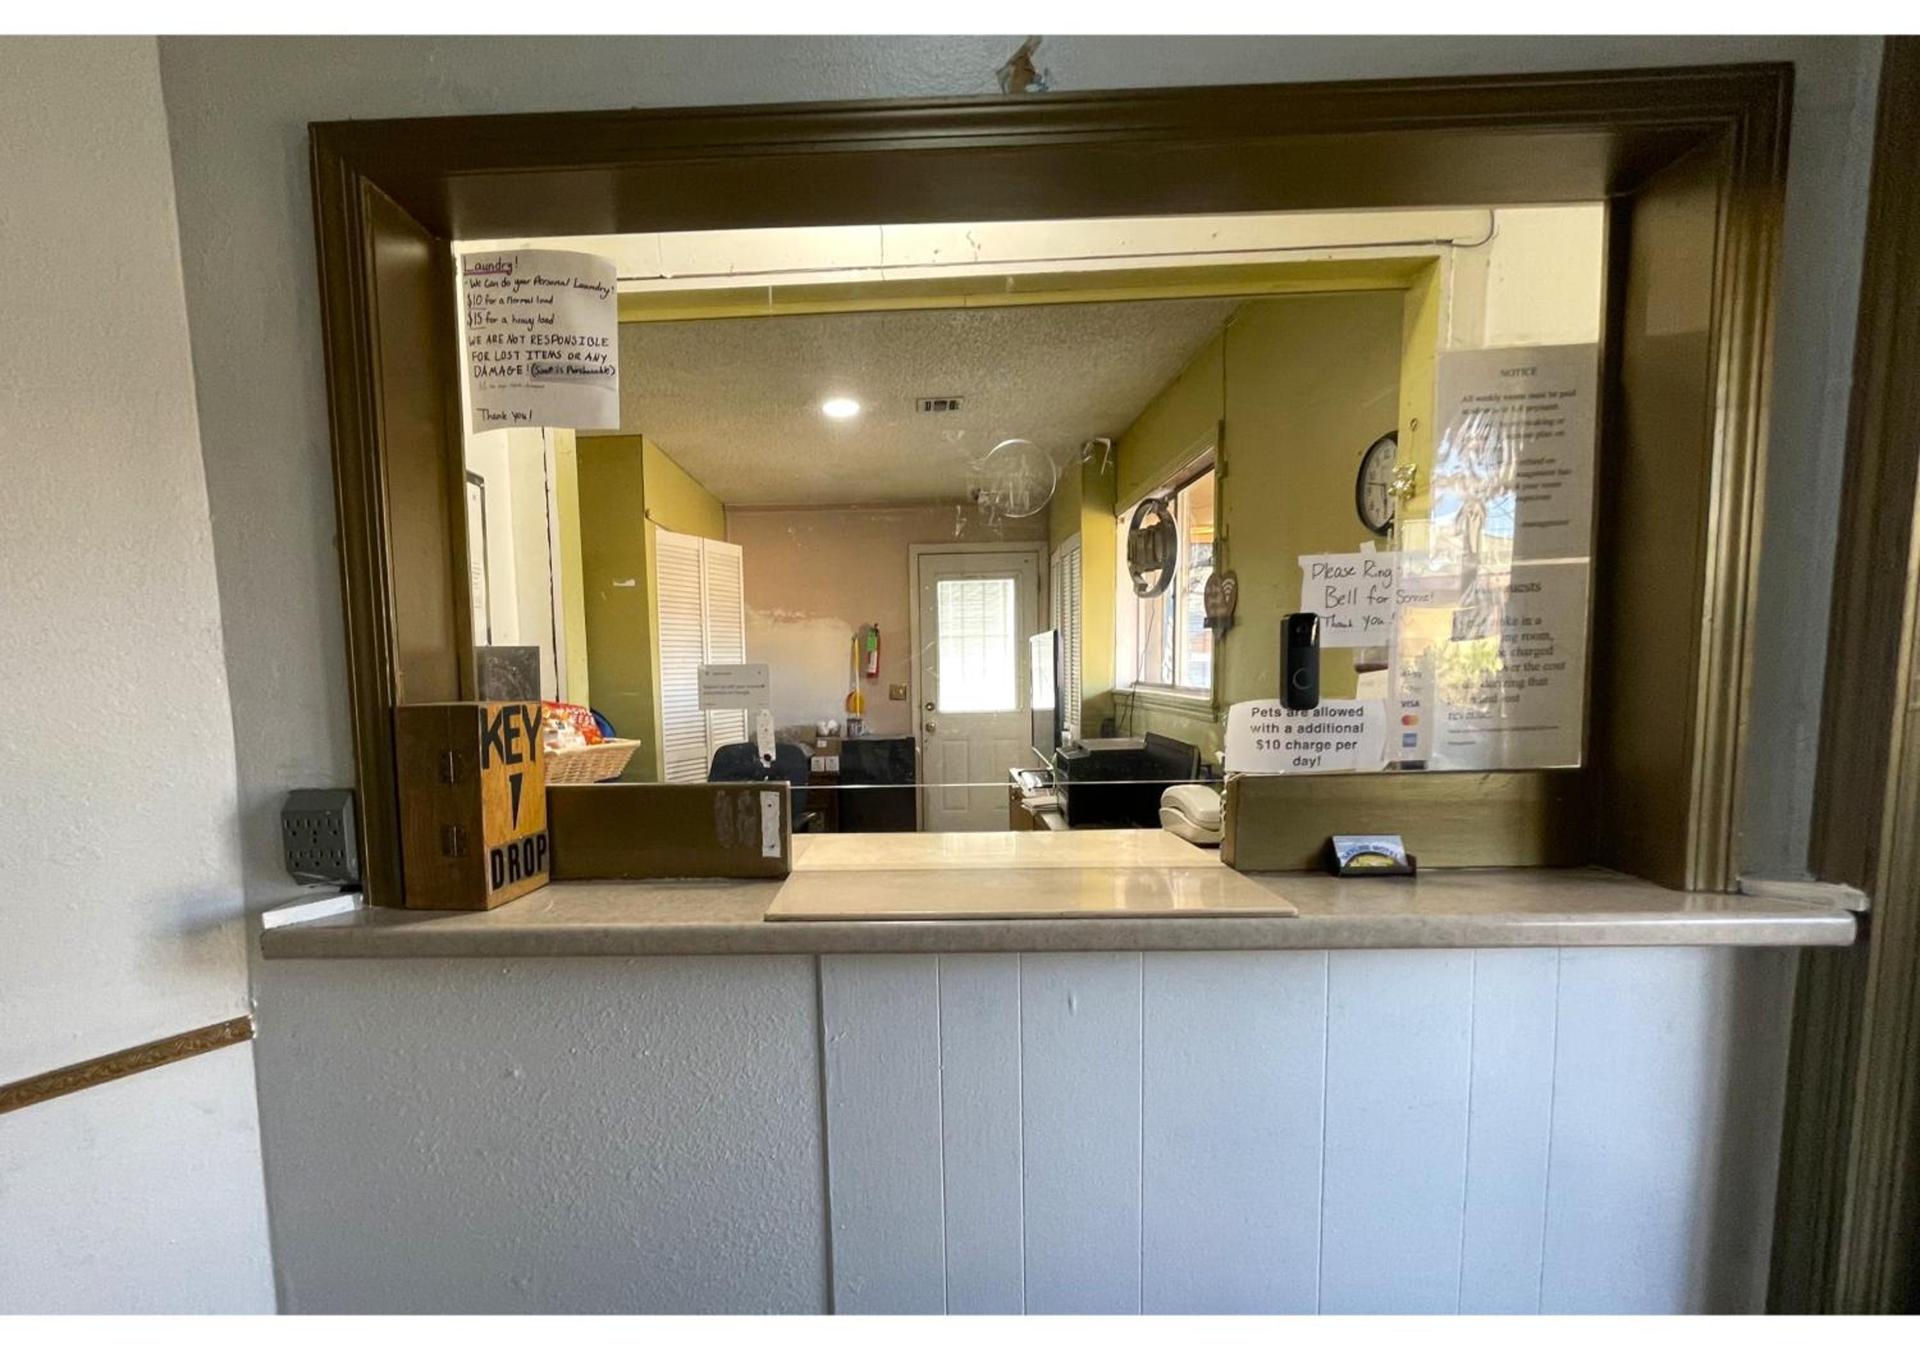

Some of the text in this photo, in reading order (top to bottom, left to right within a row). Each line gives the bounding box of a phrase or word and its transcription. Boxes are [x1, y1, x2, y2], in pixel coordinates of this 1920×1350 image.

[463, 255, 518, 275] Laundry!
[501, 276, 511, 288] do
[512, 279, 531, 293] your
[467, 293, 482, 308] $10
[485, 294, 497, 305] for
[498, 297, 505, 305] a
[467, 311, 482, 327] $15
[486, 311, 498, 323] for
[501, 316, 508, 324] a
[538, 313, 555, 324] load
[469, 334, 609, 347] WE ARE NOT RESPONSIBLE
[472, 350, 608, 364] FOR LOST ITEMS OR ANY
[477, 408, 507, 421] Thank
[1312, 559, 1393, 589] Please Ring
[1325, 585, 1358, 609] Bell
[1366, 584, 1389, 605] for
[1251, 706, 1364, 717] Pets are allowed
[1250, 723, 1364, 734] with a additional
[479, 704, 542, 770] KEY
[1256, 739, 1358, 752] $10 charge per
[1292, 756, 1322, 768] day!
[490, 833, 548, 892] DROP
